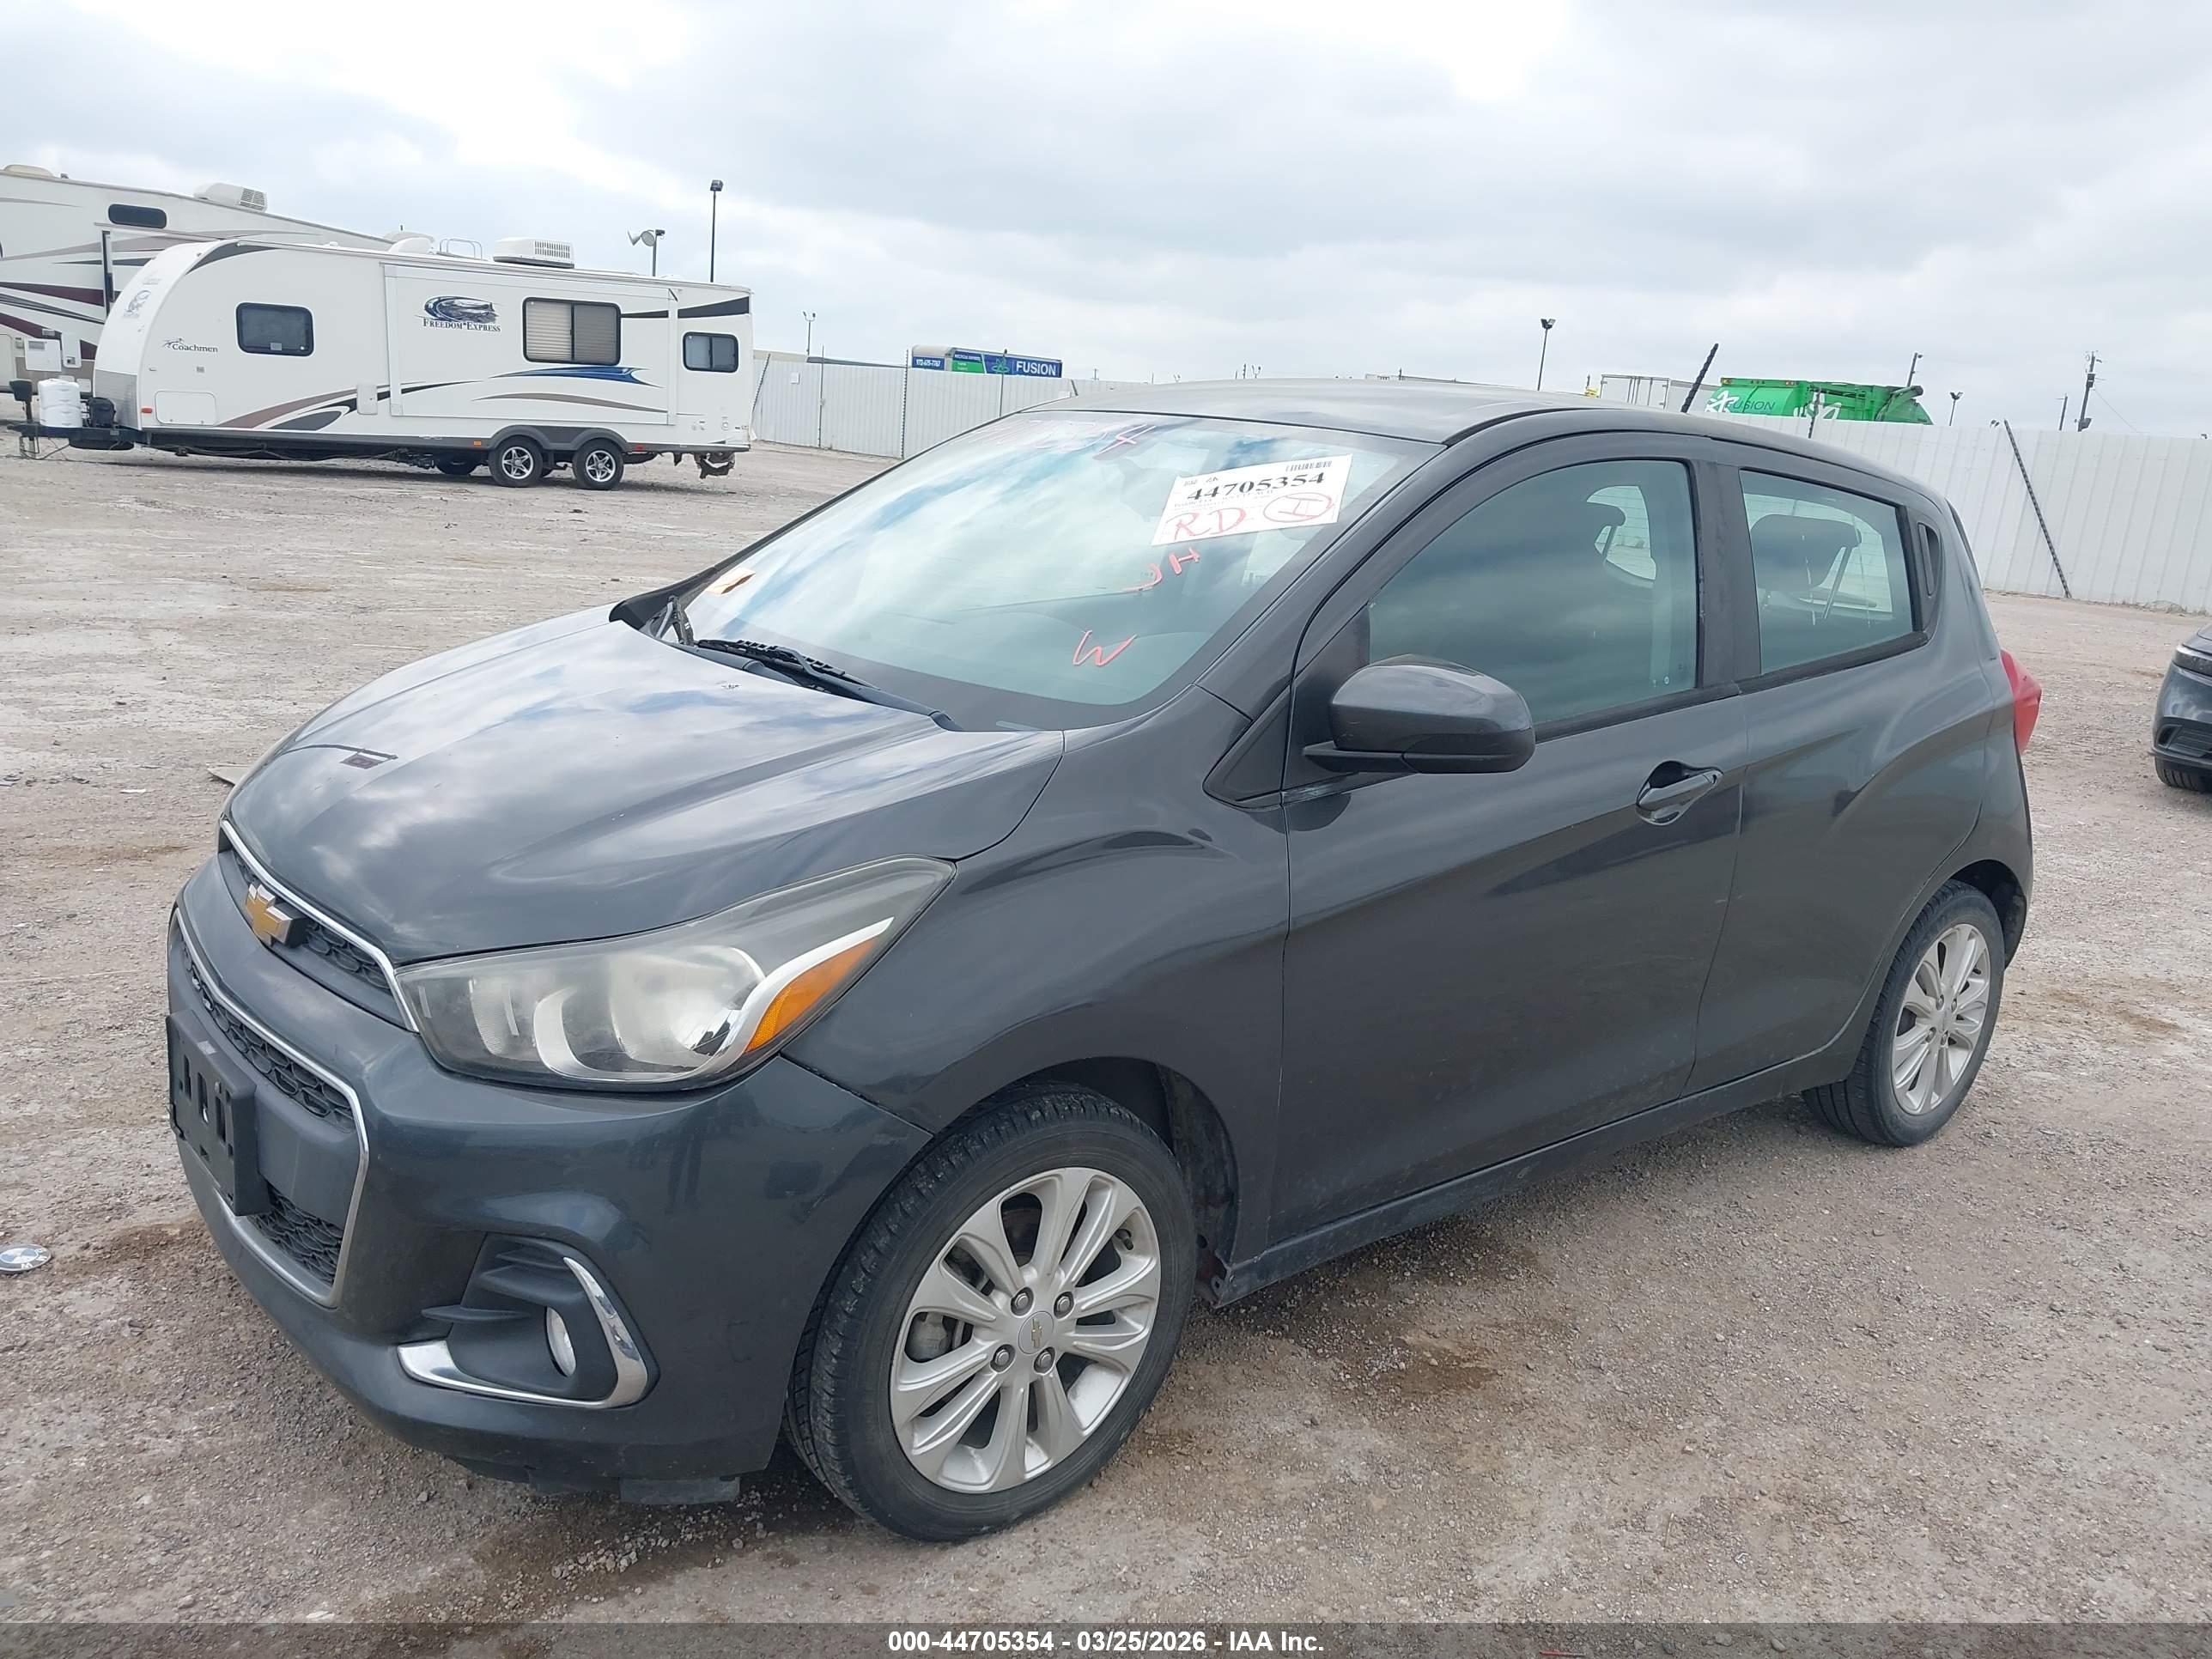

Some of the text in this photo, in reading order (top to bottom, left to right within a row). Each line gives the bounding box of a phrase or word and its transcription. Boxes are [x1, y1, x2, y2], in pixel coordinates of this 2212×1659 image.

[172, 343, 219, 353] Coachmen
[1016, 361, 1056, 376] FUSION
[1187, 472, 1325, 501] 44705354
[1073, 629, 1137, 666] W
